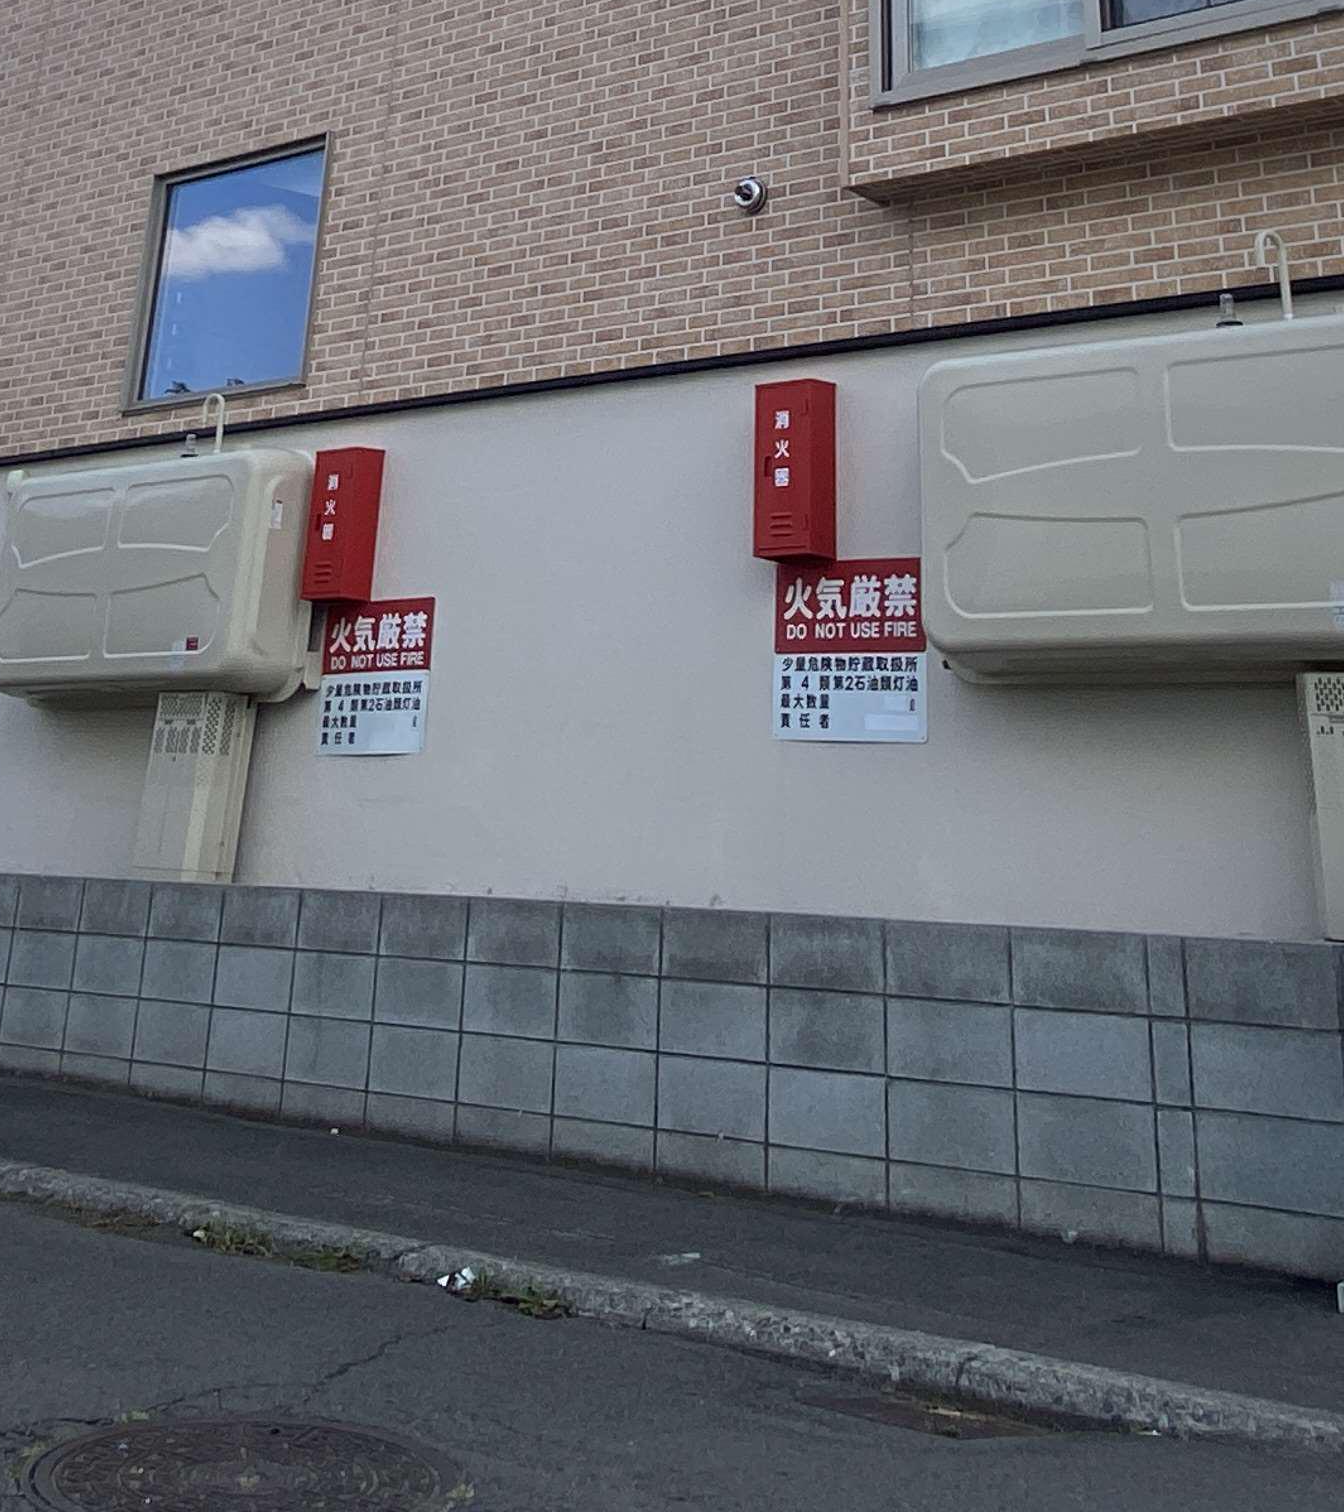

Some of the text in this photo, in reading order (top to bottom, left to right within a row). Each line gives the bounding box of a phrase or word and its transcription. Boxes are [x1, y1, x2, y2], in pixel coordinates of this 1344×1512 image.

[784, 573, 917, 619] 火気厳禁
[329, 611, 428, 653] 火気厳禁
[787, 621, 917, 639] DO NOT USE FIRE
[331, 651, 424, 670] DO NOT USE FIRE
[782, 656, 918, 672] 少量危険物貯蔵取扱所
[781, 693, 829, 709] 最大数量
